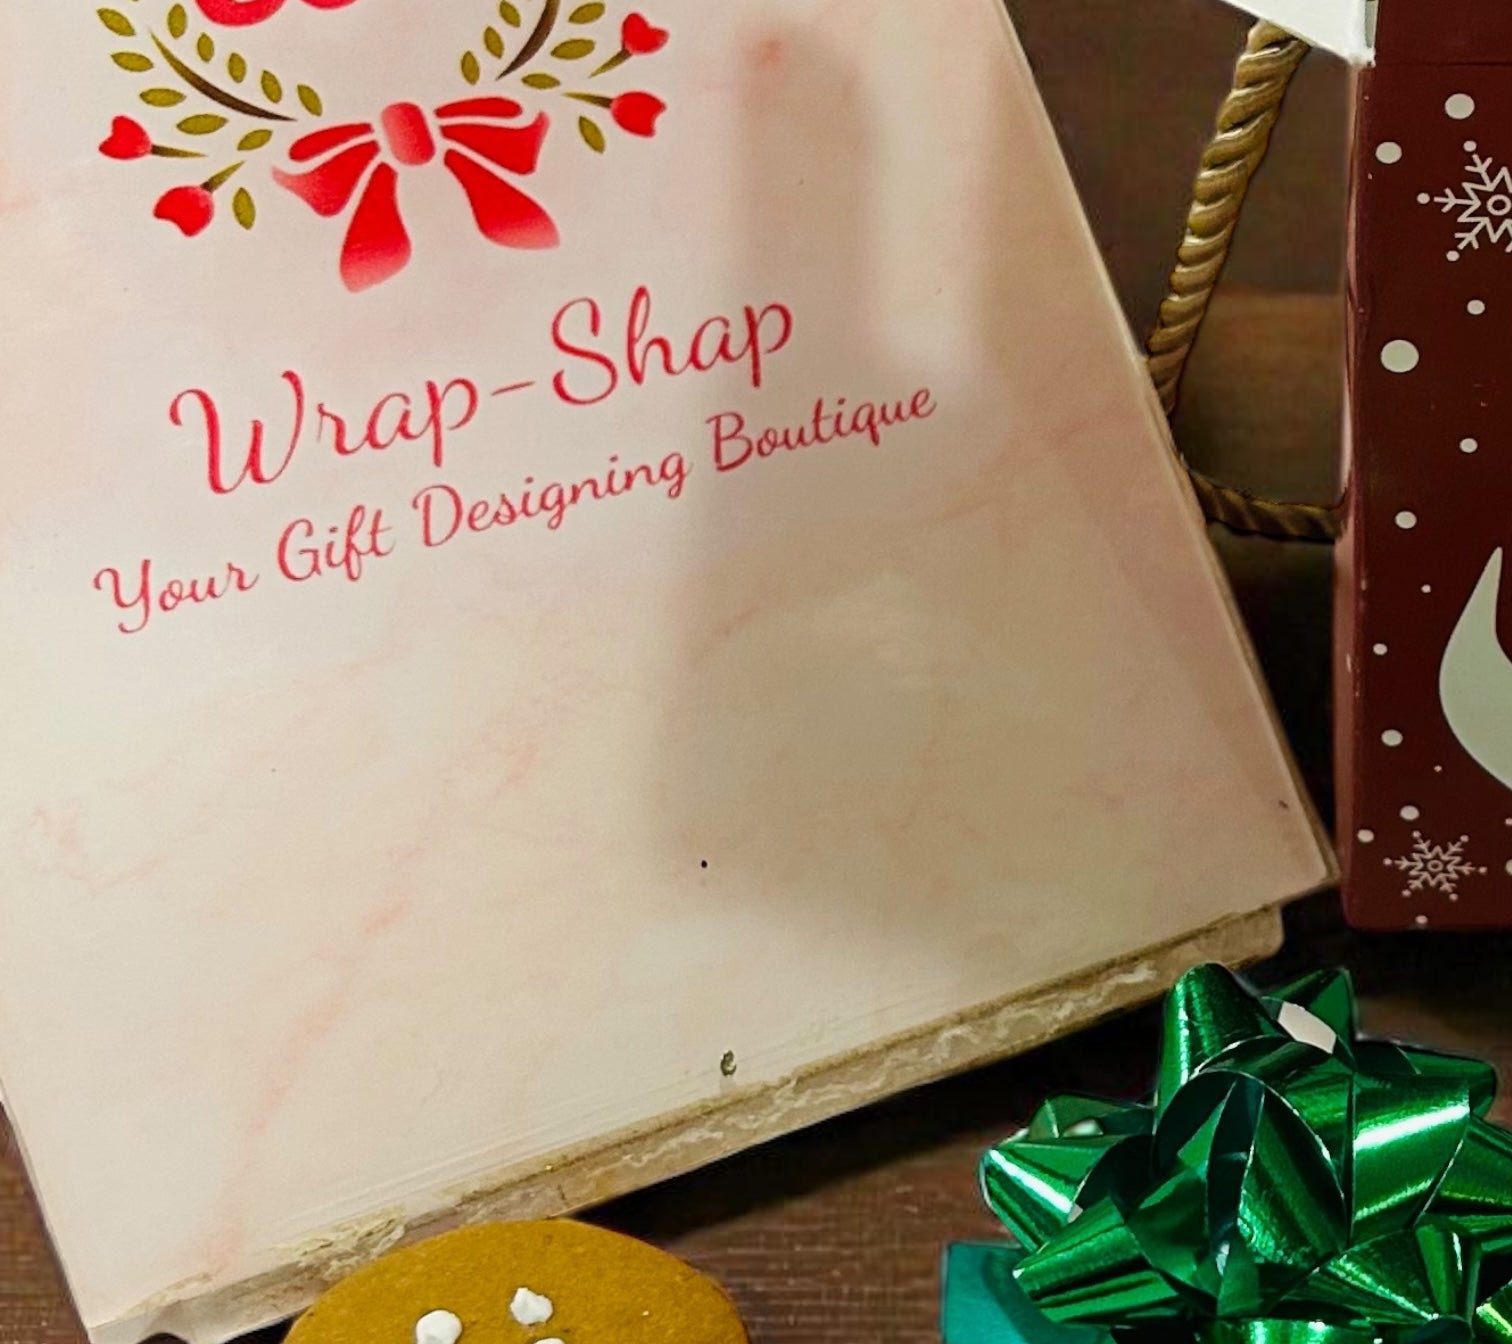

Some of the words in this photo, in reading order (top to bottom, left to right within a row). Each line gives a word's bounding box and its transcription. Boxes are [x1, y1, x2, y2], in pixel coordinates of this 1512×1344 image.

[169, 286, 794, 495] Wrap-Shap
[94, 560, 258, 634] Your
[277, 504, 394, 582] Gift
[411, 454, 689, 548] Designing
[706, 386, 938, 473] Boutique
